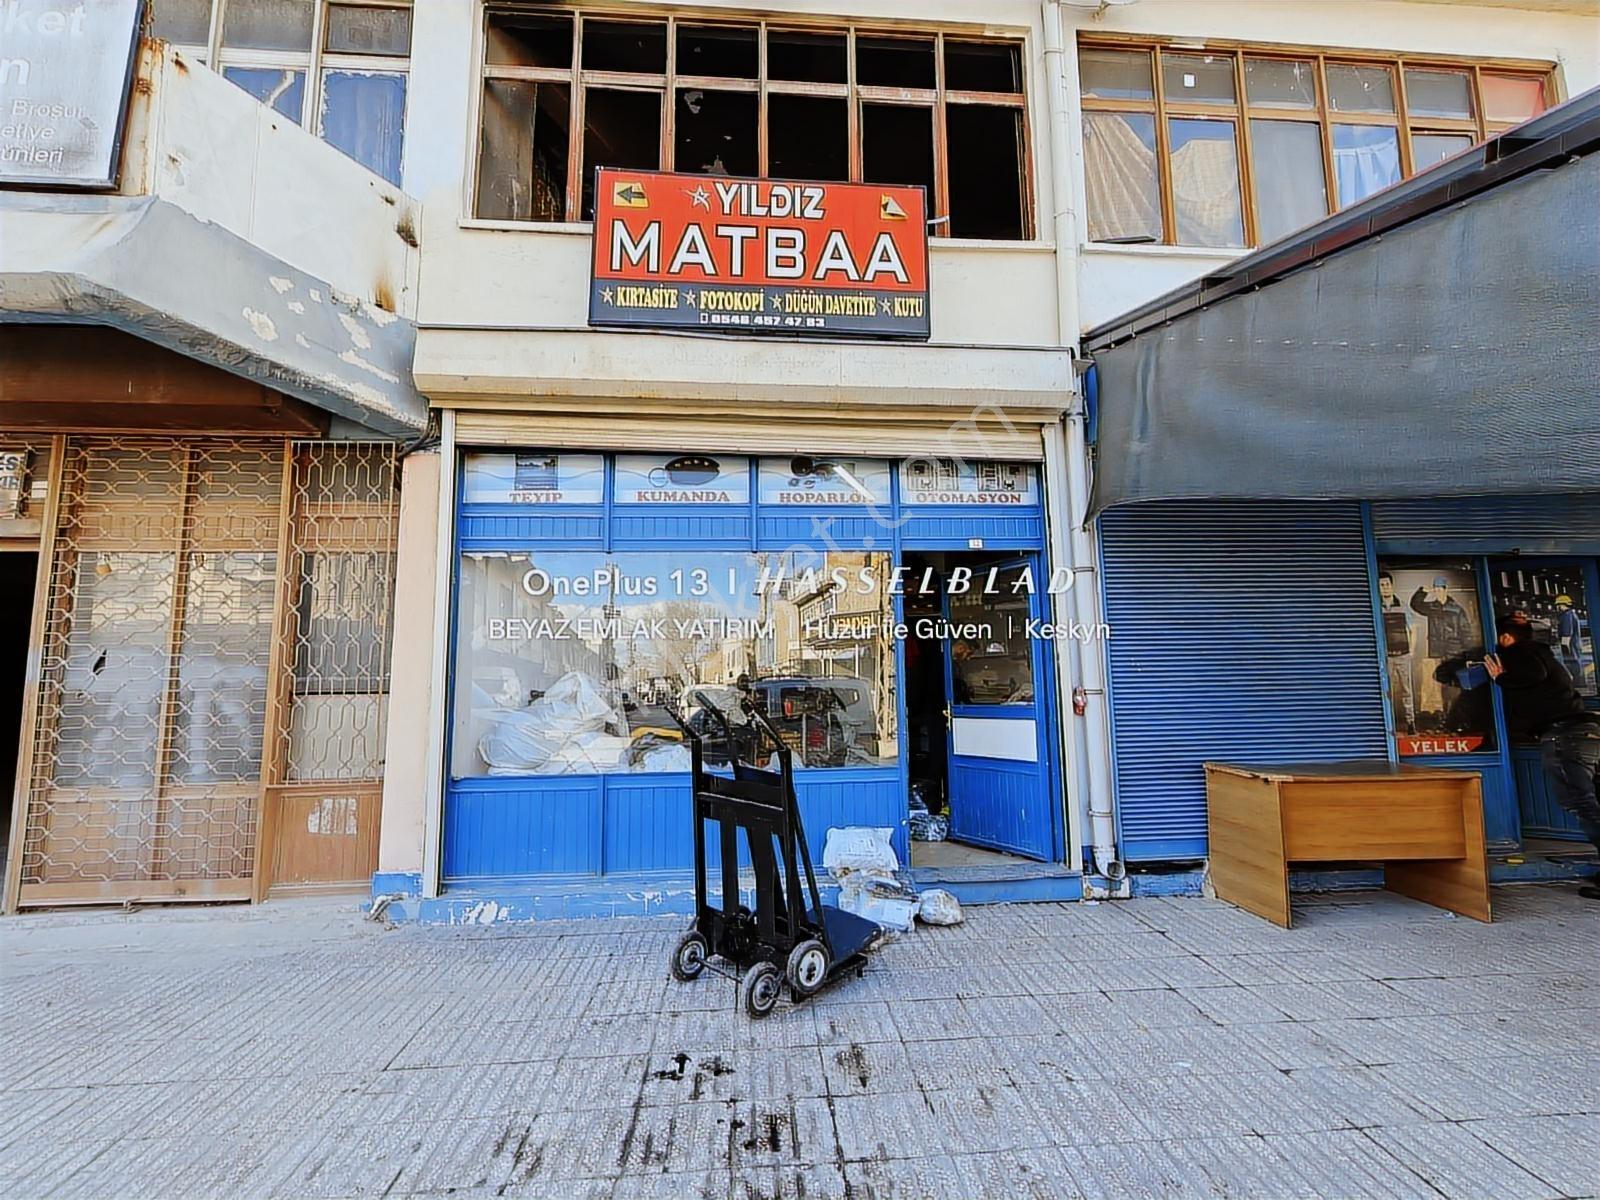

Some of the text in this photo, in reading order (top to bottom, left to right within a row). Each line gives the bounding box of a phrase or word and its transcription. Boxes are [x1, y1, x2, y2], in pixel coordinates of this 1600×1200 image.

[0, 0, 86, 36] ket
[713, 181, 827, 219] YILDIZ
[609, 217, 910, 284] MATBAA
[616, 283, 923, 317] KIRTASİYE FOTOKOPİ DÜĞÜN DAVETİYE KUTU
[784, 316, 802, 326] 47
[636, 490, 731, 503] KUMANDA
[916, 491, 1022, 504] OTOMASYON
[1409, 740, 1471, 753] YELEK
